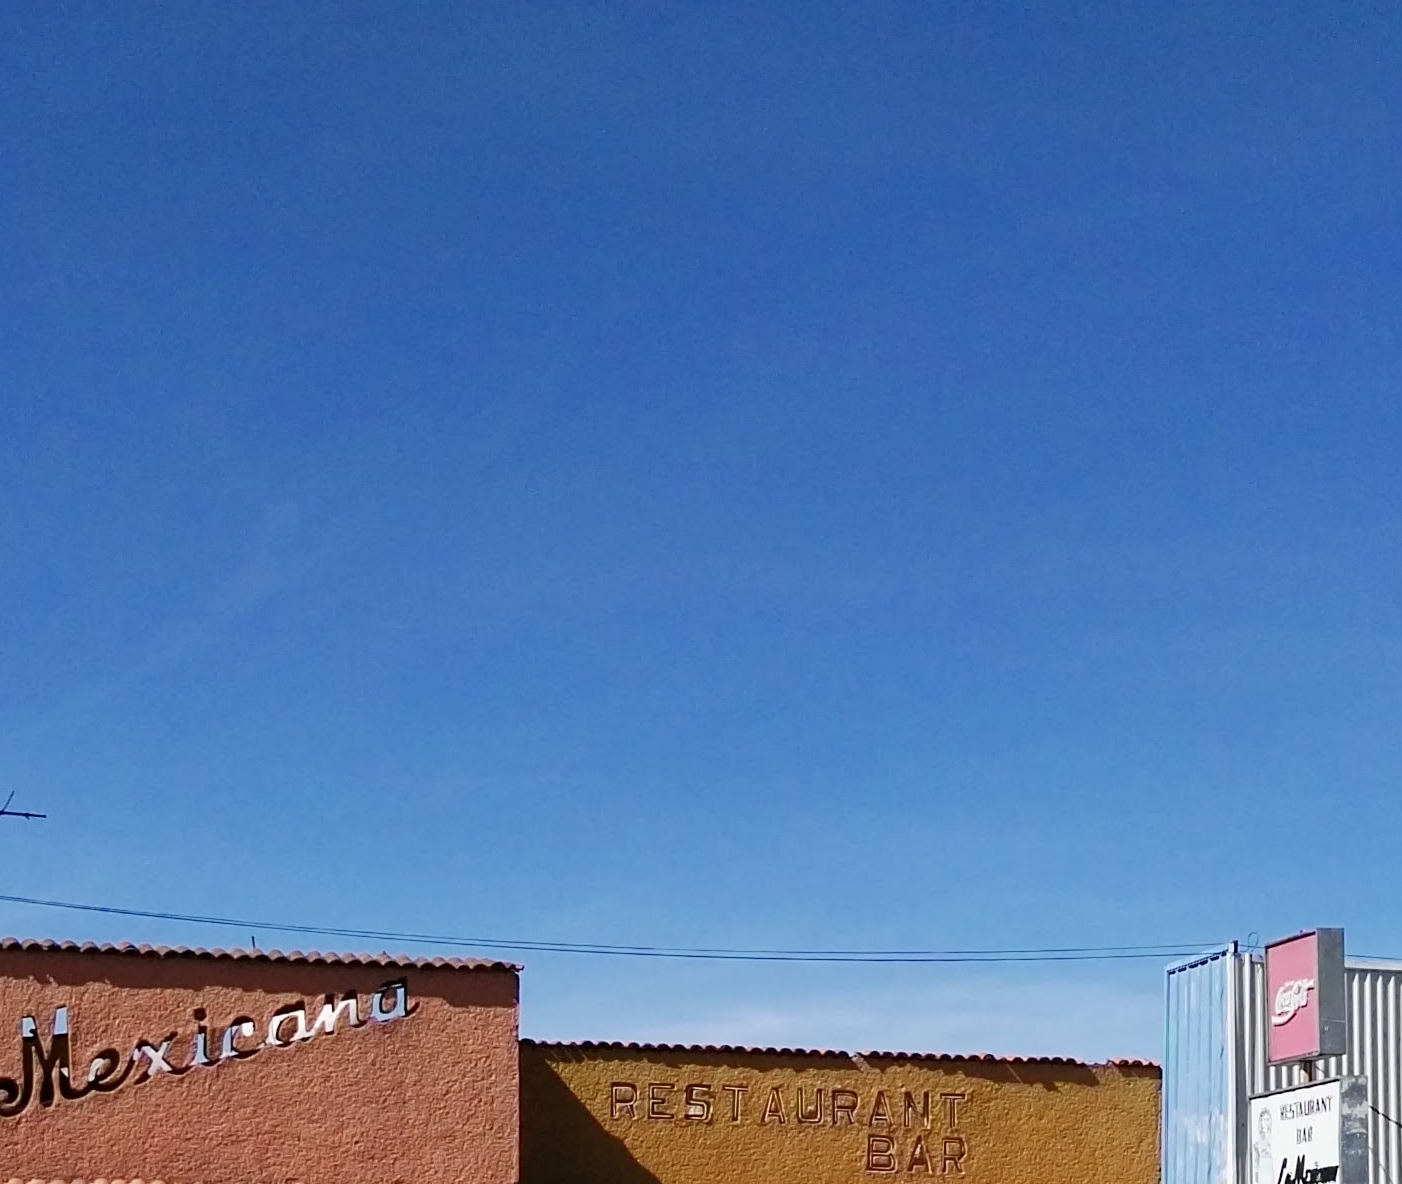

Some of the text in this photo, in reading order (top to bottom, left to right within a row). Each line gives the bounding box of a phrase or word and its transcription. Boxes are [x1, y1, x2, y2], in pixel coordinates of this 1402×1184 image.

[610, 1082, 966, 1129] RESTAURANT
[1280, 1096, 1332, 1120] RESTAURANT
[1296, 1126, 1313, 1144] BAR
[866, 1134, 967, 1174] BAR
